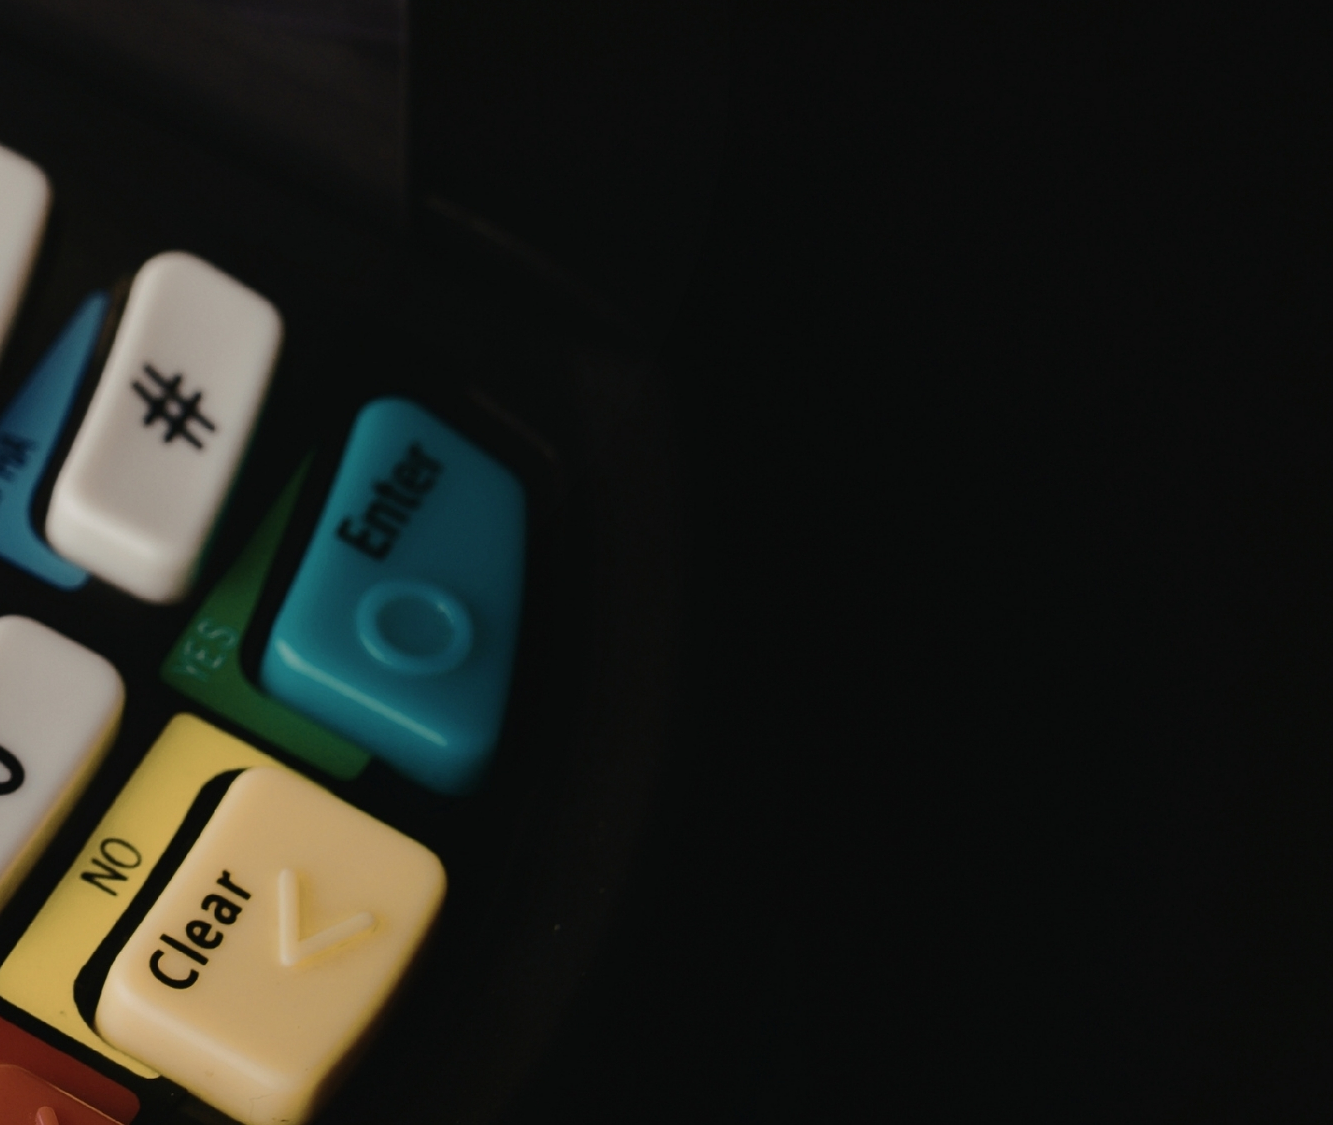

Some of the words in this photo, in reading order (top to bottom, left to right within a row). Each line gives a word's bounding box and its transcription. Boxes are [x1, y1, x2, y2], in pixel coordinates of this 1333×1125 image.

[130, 363, 217, 451] #
[336, 438, 446, 562] Enter
[173, 618, 238, 683] YES
[79, 836, 144, 897] NO
[148, 869, 257, 991] Clear
